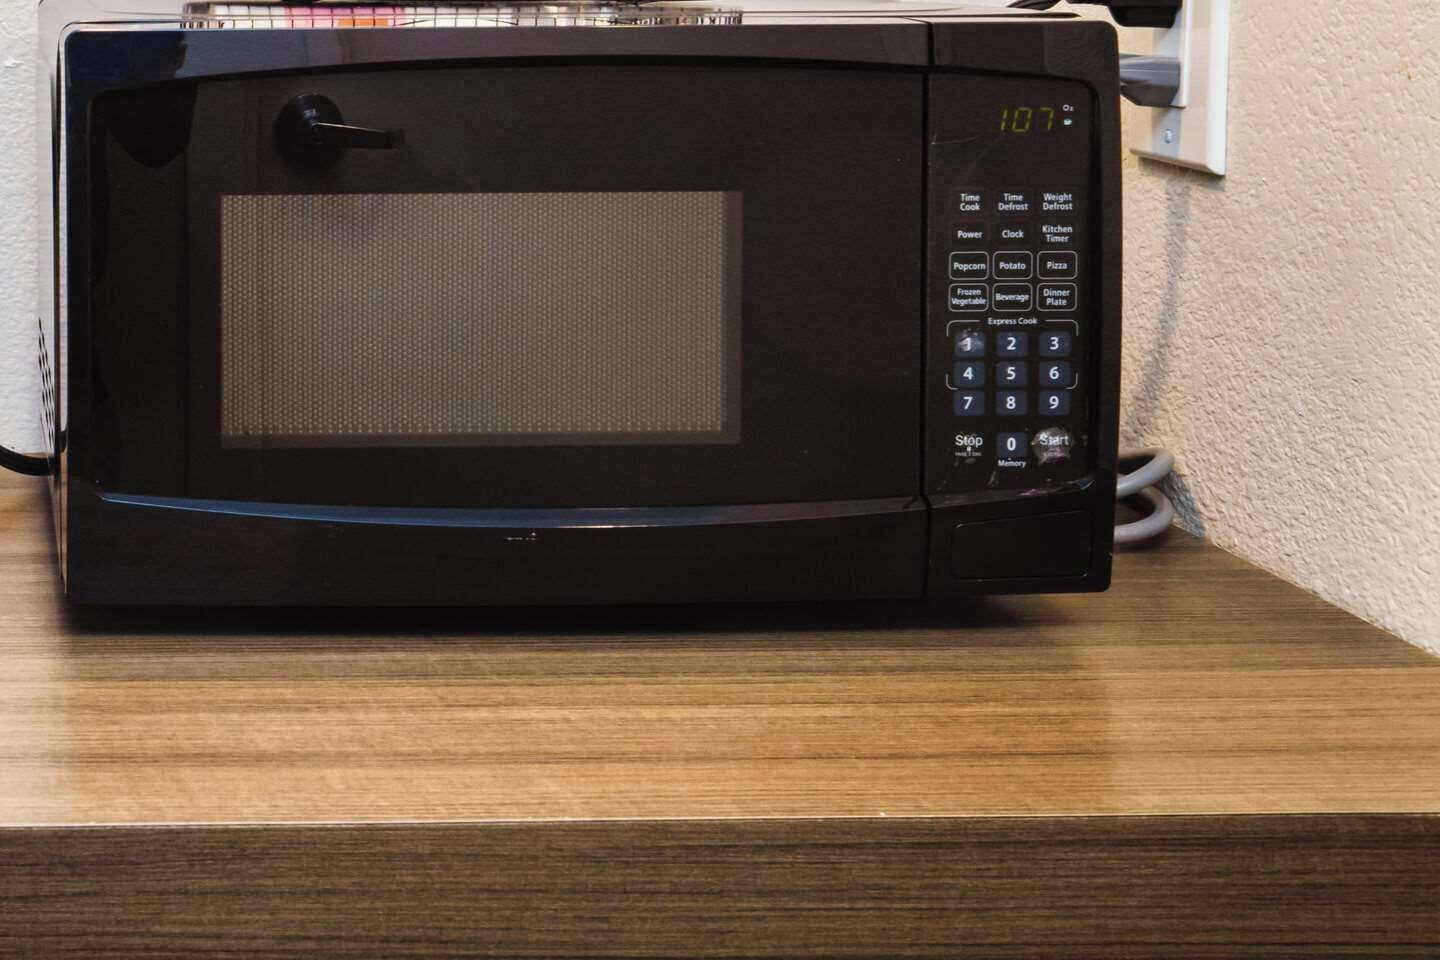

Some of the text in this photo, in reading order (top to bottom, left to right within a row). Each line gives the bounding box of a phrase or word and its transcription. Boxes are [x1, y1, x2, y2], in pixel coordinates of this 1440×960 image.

[960, 193, 980, 201] Time
[1003, 193, 1023, 201] Time
[1043, 193, 1072, 203] Weight
[960, 203, 980, 211] Cook
[998, 202, 1028, 211] Defrost
[1042, 202, 1073, 210] Defrost
[1042, 225, 1073, 233] Kitchen
[957, 230, 982, 238] Power
[1001, 230, 1024, 238] Clock
[1046, 234, 1069, 242] Timer
[953, 262, 986, 271] Popcorn
[999, 262, 1026, 270] Potato
[1047, 262, 1067, 270] Pizza
[957, 288, 981, 296] Frozen
[1043, 288, 1070, 297] Dinner
[951, 297, 986, 306] Vegetable
[995, 293, 1029, 302] Beverage
[1046, 298, 1067, 306] Plate
[988, 318, 1017, 326] Express
[1006, 337, 1016, 350] 2
[1049, 336, 1059, 350] 3
[963, 367, 973, 380] 4
[1006, 366, 1016, 380] 5
[1049, 366, 1059, 380] 6
[963, 396, 973, 410] 7
[1006, 396, 1016, 409] 8
[1049, 396, 1059, 409] 9
[955, 435, 983, 448] Stop
[1040, 433, 1069, 445] Start
[1006, 437, 1016, 451] 0
[998, 460, 1026, 468] Memory
